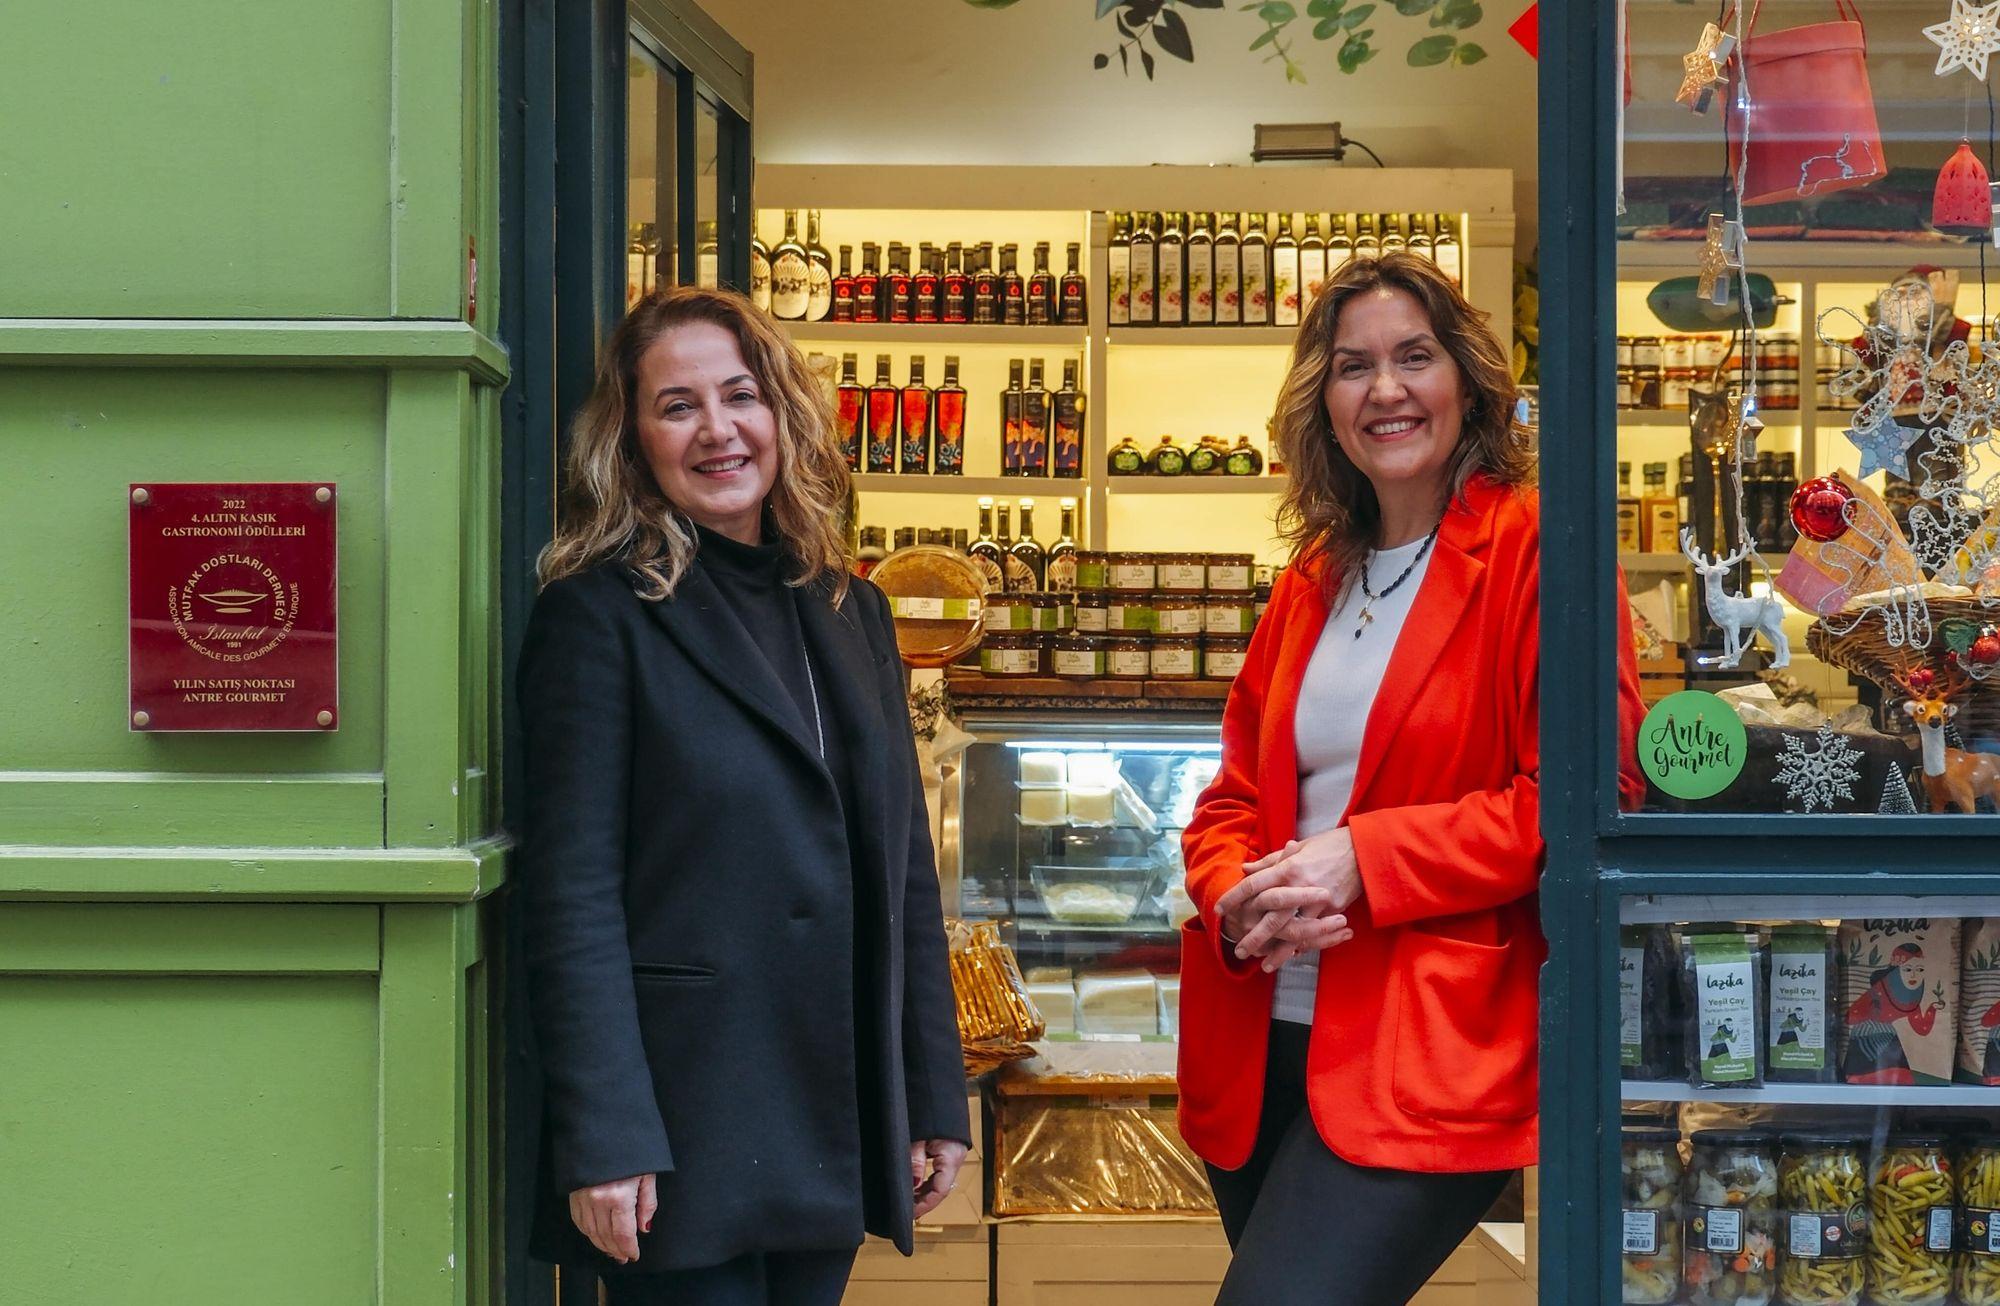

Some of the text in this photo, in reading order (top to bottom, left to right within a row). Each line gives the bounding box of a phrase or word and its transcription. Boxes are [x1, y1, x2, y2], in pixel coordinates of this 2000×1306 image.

[222, 499, 246, 509] 2022
[191, 513, 277, 525] 4. ALTIN KAŞIK
[162, 525, 306, 537] GASTRONOMİ ÖDÜLLERİ
[181, 554, 287, 622] MUTFAK DOSTLARI DERNEĞİ
[168, 582, 300, 663] ASSOCIATION AMICALE DES GOURMETS EN TURQUIE
[173, 679, 296, 691] YILIN SATIŞ NOKTASI
[183, 692, 286, 703] ANTRE GOURMET
[1650, 713, 1728, 755] Antre
